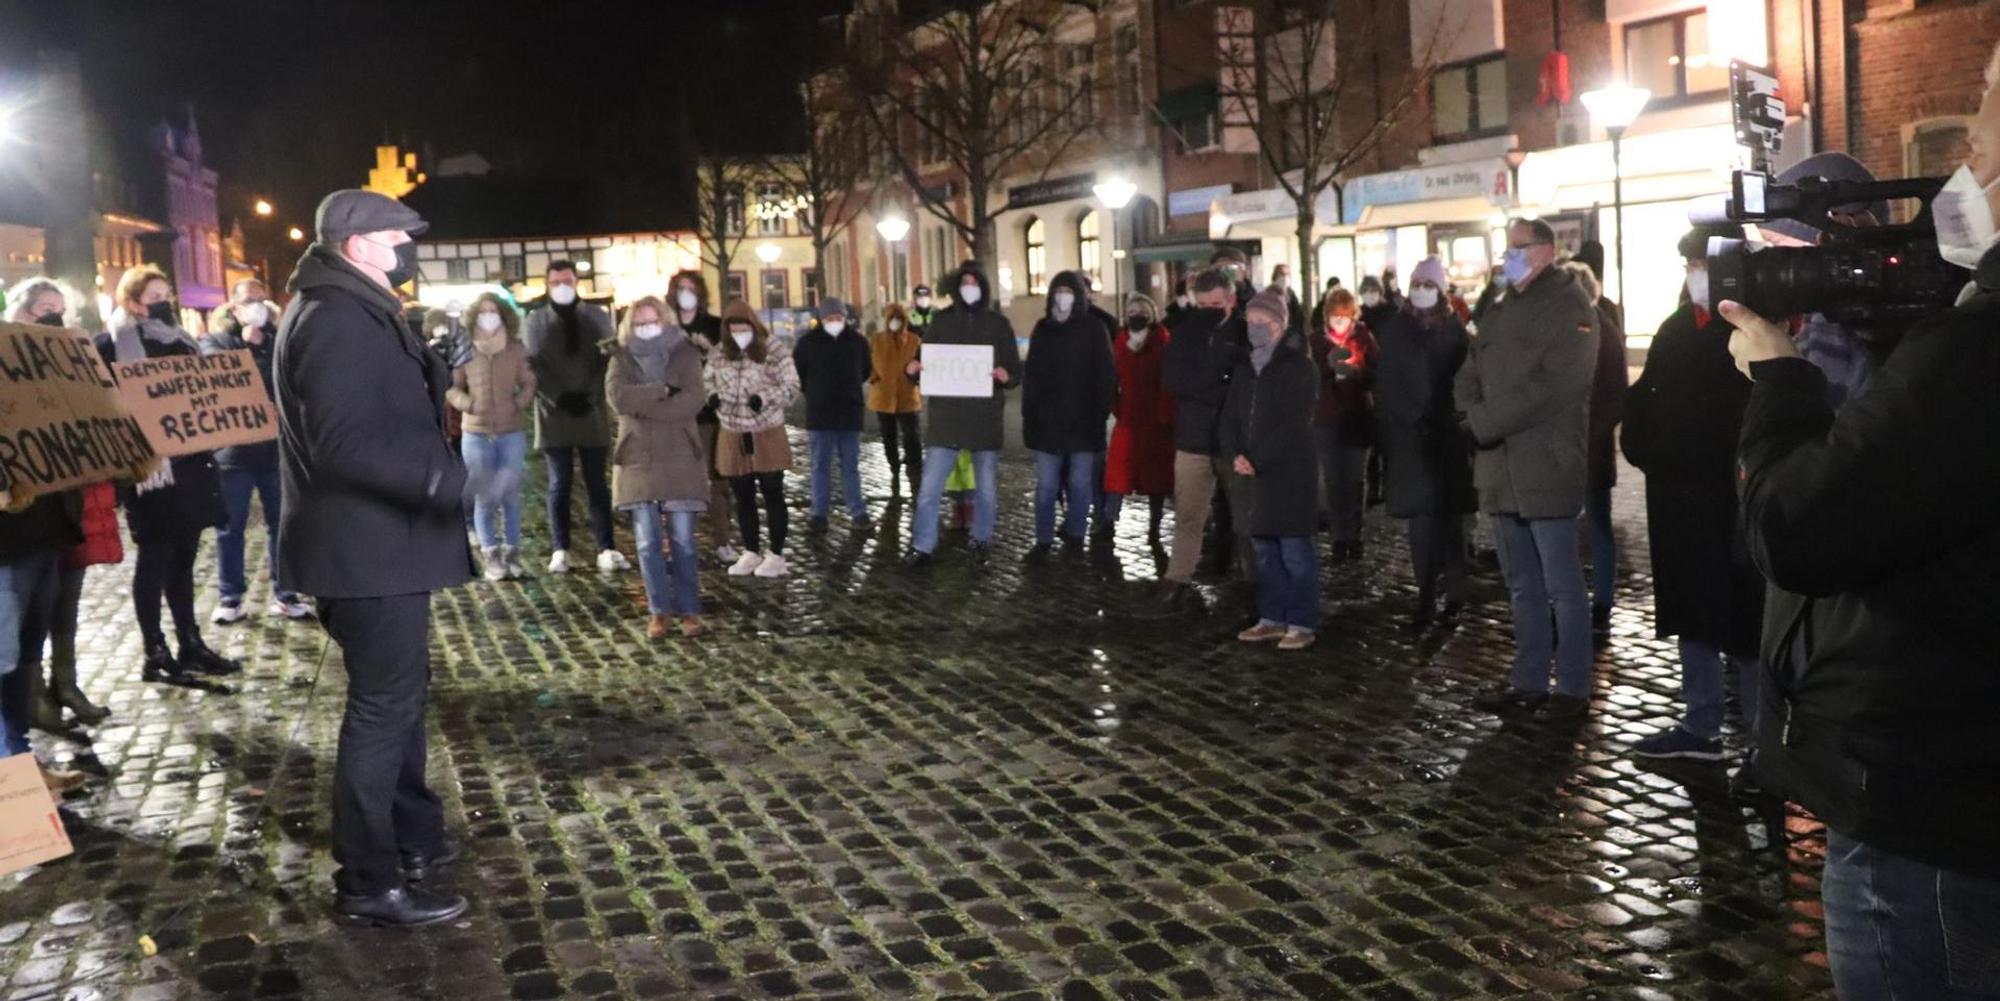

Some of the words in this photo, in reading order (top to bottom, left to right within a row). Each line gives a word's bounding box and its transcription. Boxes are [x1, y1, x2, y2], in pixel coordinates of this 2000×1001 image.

[121, 353, 242, 378] DEMOKRATEN
[146, 374, 208, 398] LAUFEN
[210, 370, 251, 390] NICHT
[190, 393, 219, 411] MIT
[160, 404, 268, 444] RECHTEN
[0, 415, 155, 490] RONATOTEN
